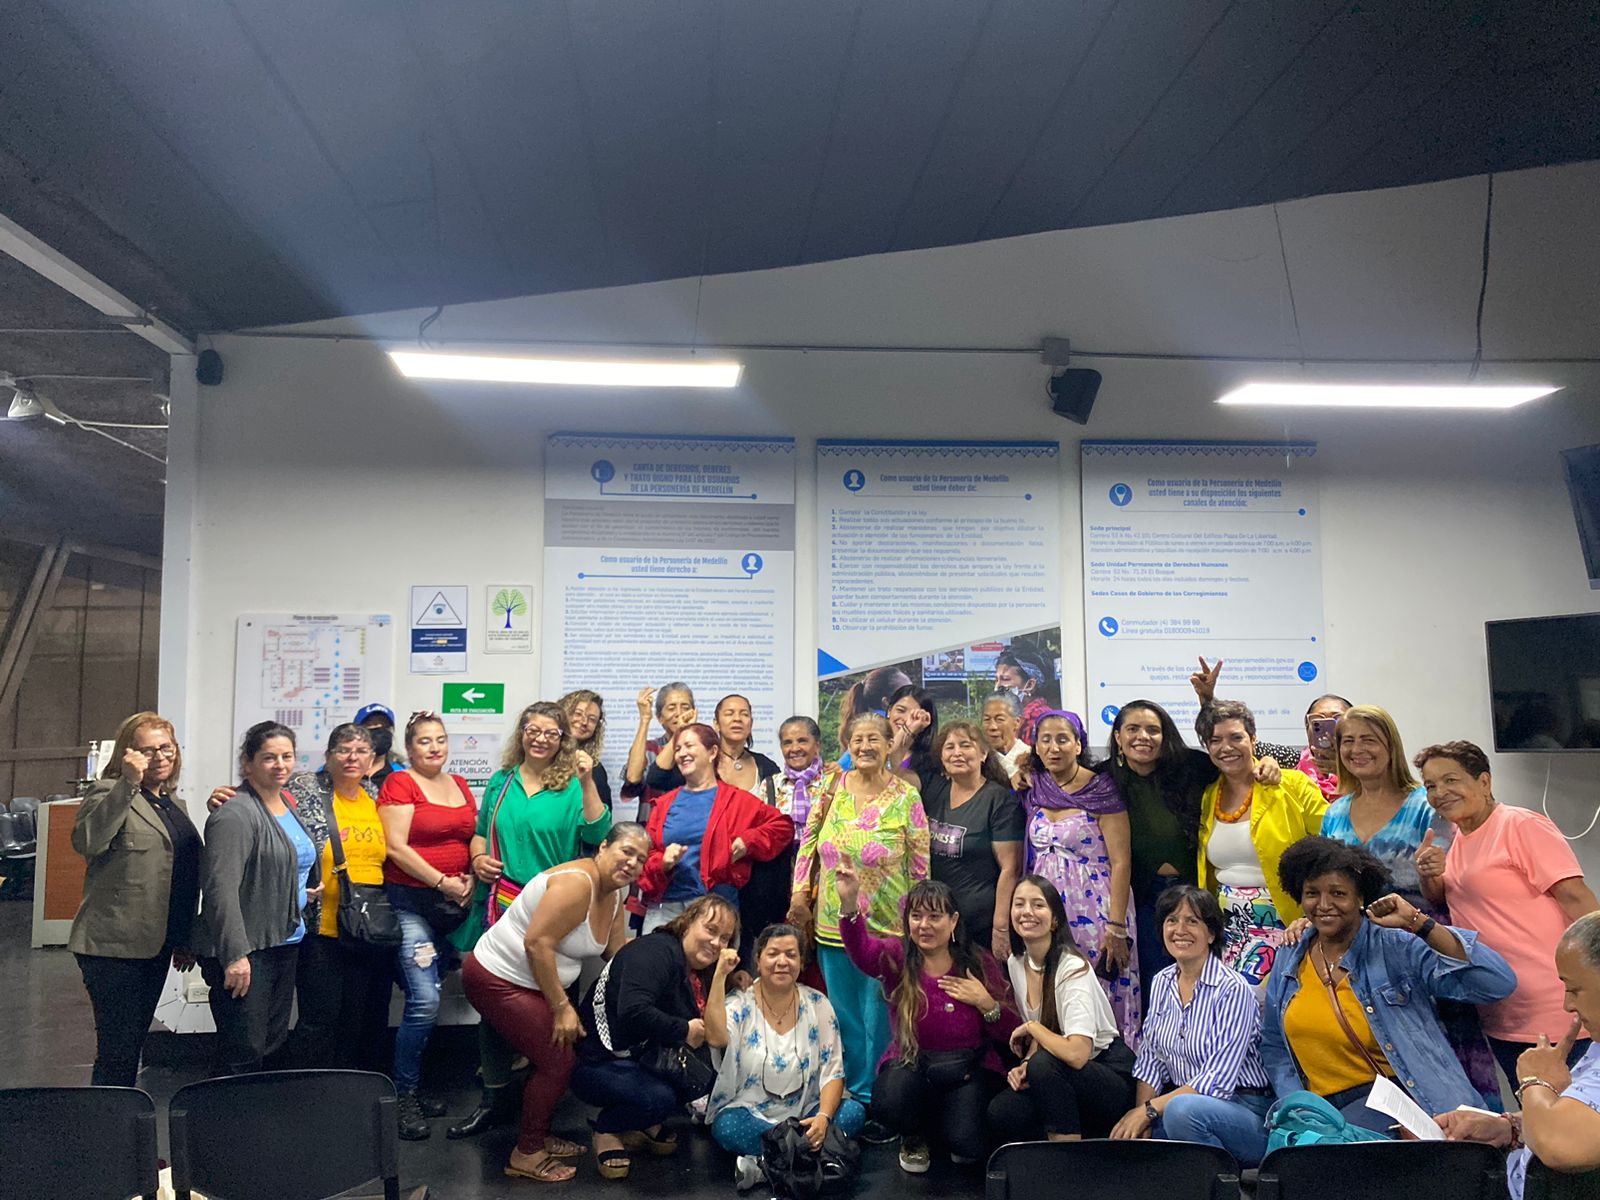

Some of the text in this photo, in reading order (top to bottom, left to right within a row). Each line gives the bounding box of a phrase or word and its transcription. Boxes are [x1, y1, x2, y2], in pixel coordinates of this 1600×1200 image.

[880, 474, 896, 482] Como
[898, 474, 921, 482] usuario
[939, 474, 972, 482] Personería
[1147, 479, 1165, 487] Como
[1166, 479, 1191, 487] usuario
[1209, 479, 1243, 487] Personería
[649, 485, 690, 493] PERSONERÍA
[701, 485, 734, 494] MEDELLÍN
[1148, 489, 1166, 498] usted
[1167, 489, 1184, 498] tiene
[1200, 489, 1236, 498] disposición
[1237, 489, 1247, 498] los
[1248, 489, 1282, 498] siguientes
[1183, 499, 1207, 507] canales
[1218, 499, 1248, 507] atención:
[659, 556, 691, 564] Personería
[701, 557, 728, 565] Medellín
